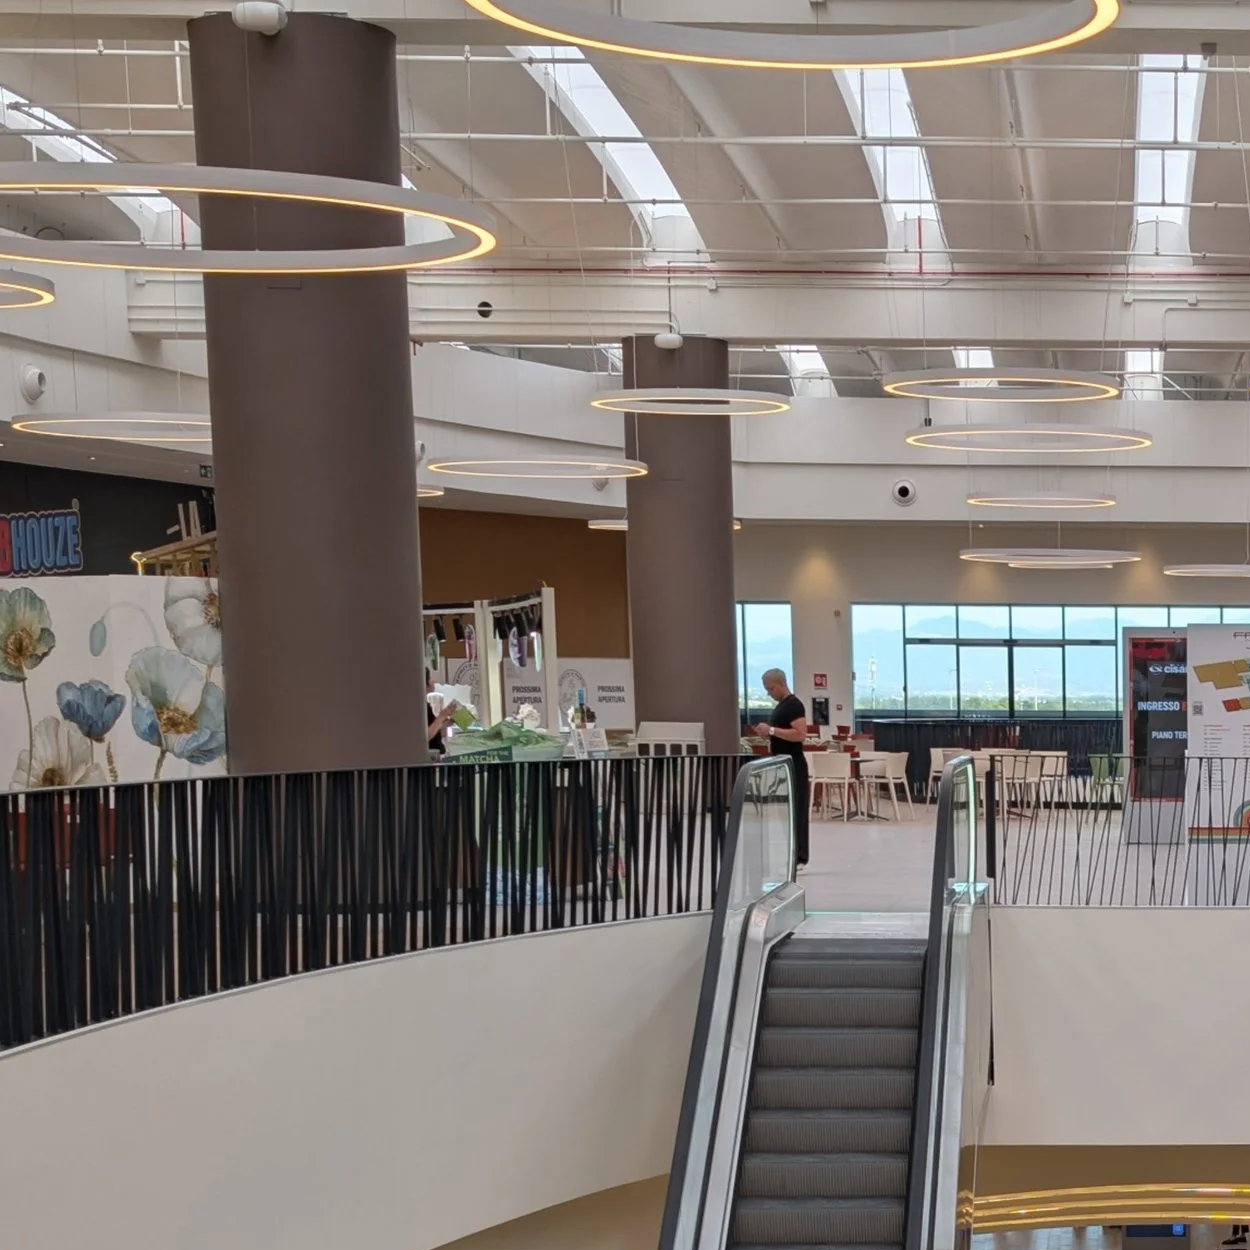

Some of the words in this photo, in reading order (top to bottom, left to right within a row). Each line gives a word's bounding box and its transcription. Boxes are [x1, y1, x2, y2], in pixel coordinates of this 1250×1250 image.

[1138, 701, 1180, 711] INGRESSO
[1152, 730, 1173, 739] PIANO
[1175, 730, 1188, 739] TER
